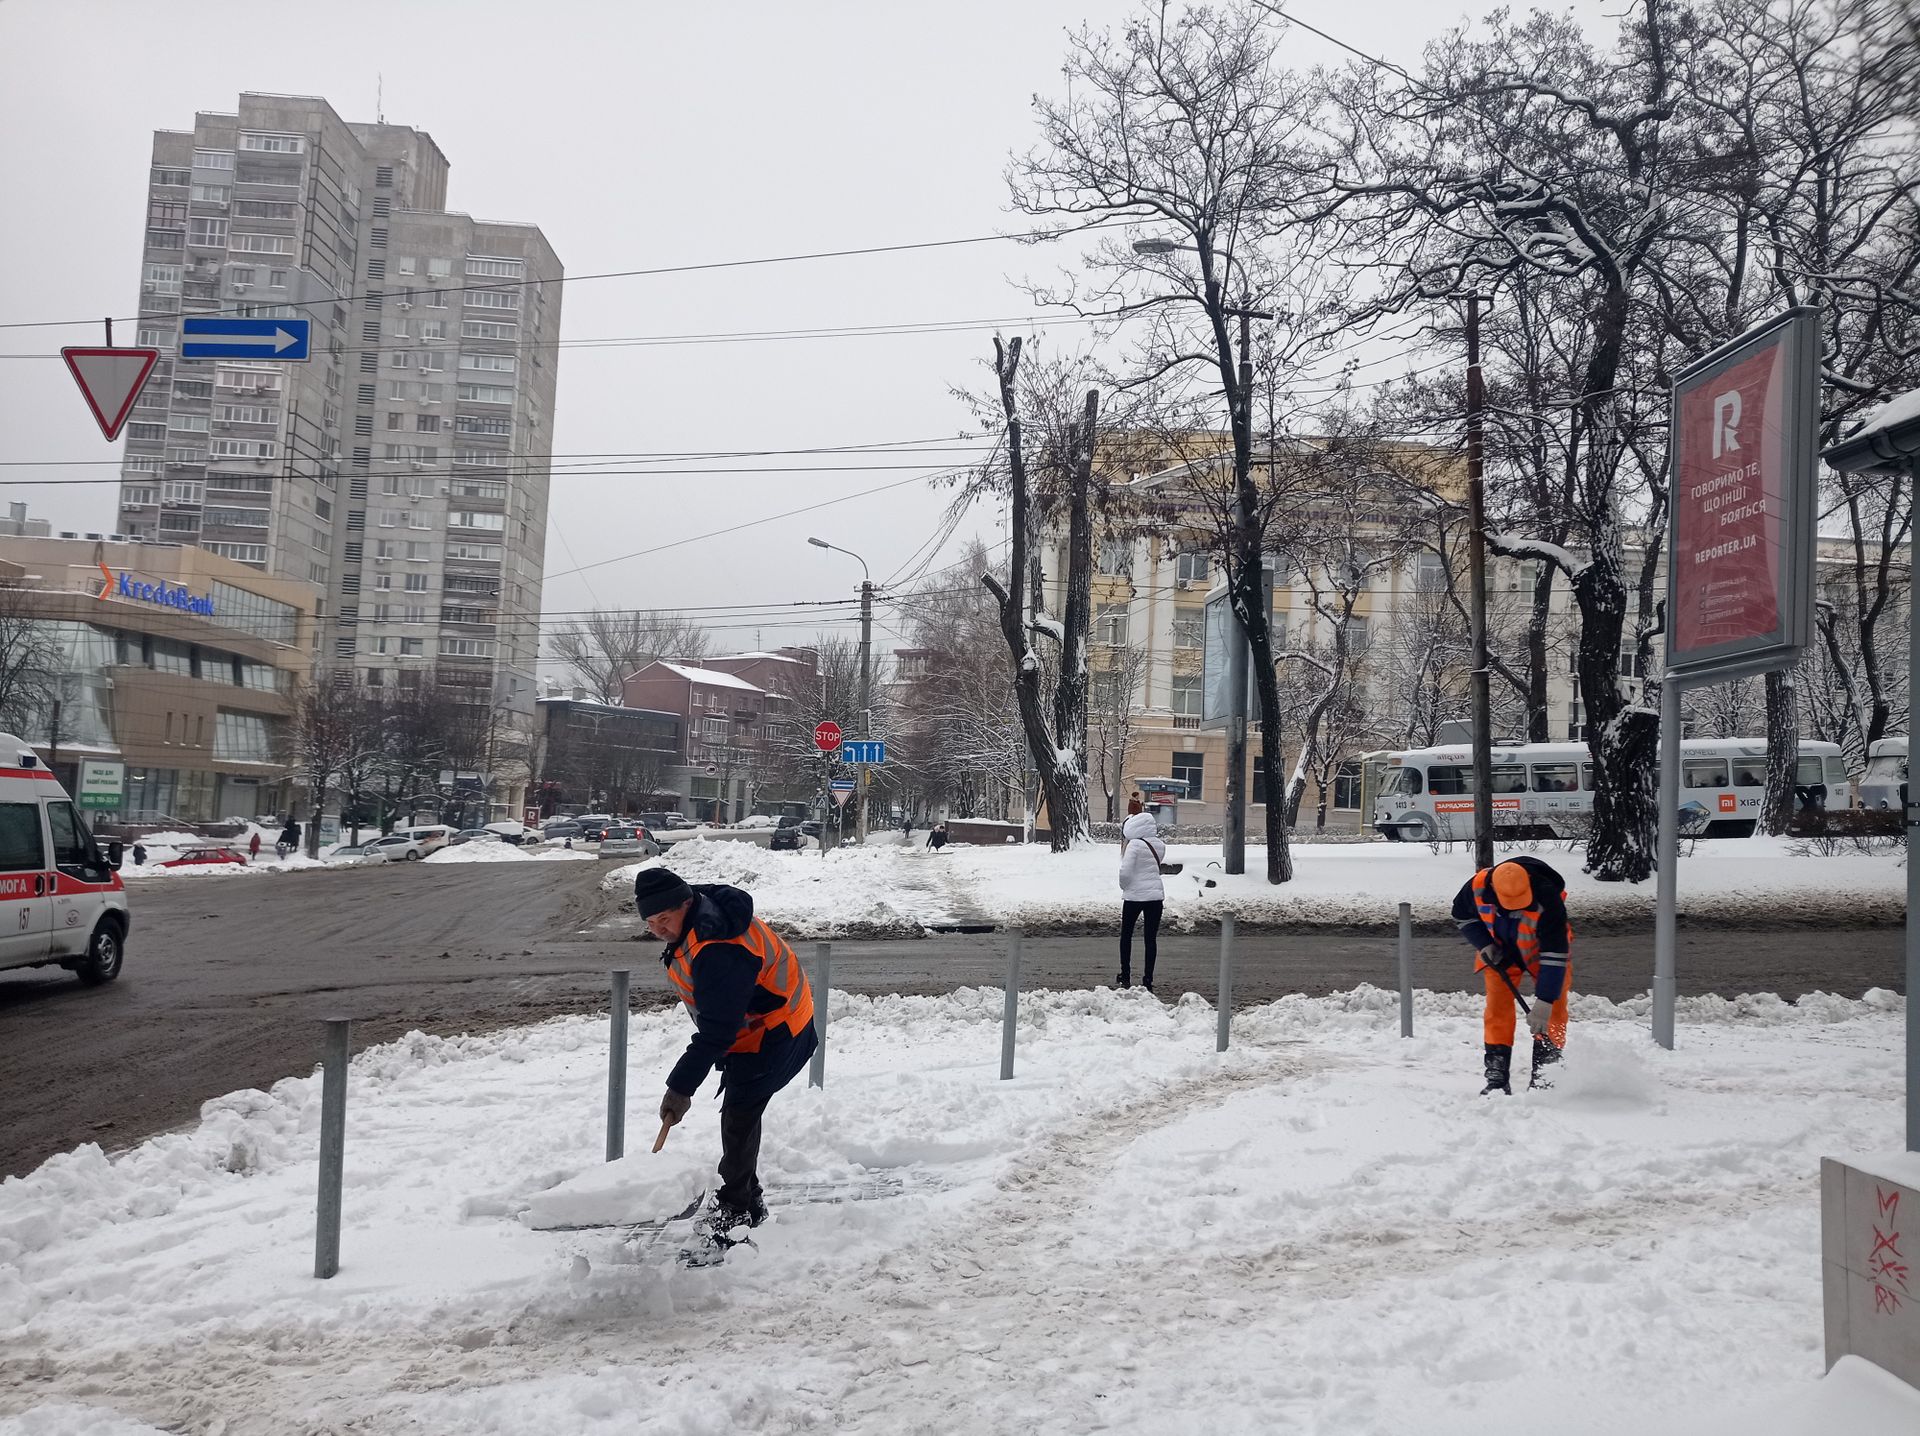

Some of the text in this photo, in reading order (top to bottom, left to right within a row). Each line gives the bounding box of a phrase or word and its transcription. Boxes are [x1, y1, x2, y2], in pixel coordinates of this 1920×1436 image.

[1713, 389, 1742, 460] R
[1691, 462, 1761, 500] ГОВОРИМО ТЕ,
[1703, 486, 1747, 514] ЩО ІНШІ
[1720, 499, 1767, 527] БОЯТЬСЯ
[1695, 534, 1757, 565] REPORTER.UA
[119, 571, 214, 616] KredoBank
[815, 730, 840, 742] STOP
[1395, 801, 1407, 809] 1413
[18, 907, 31, 931] 157
